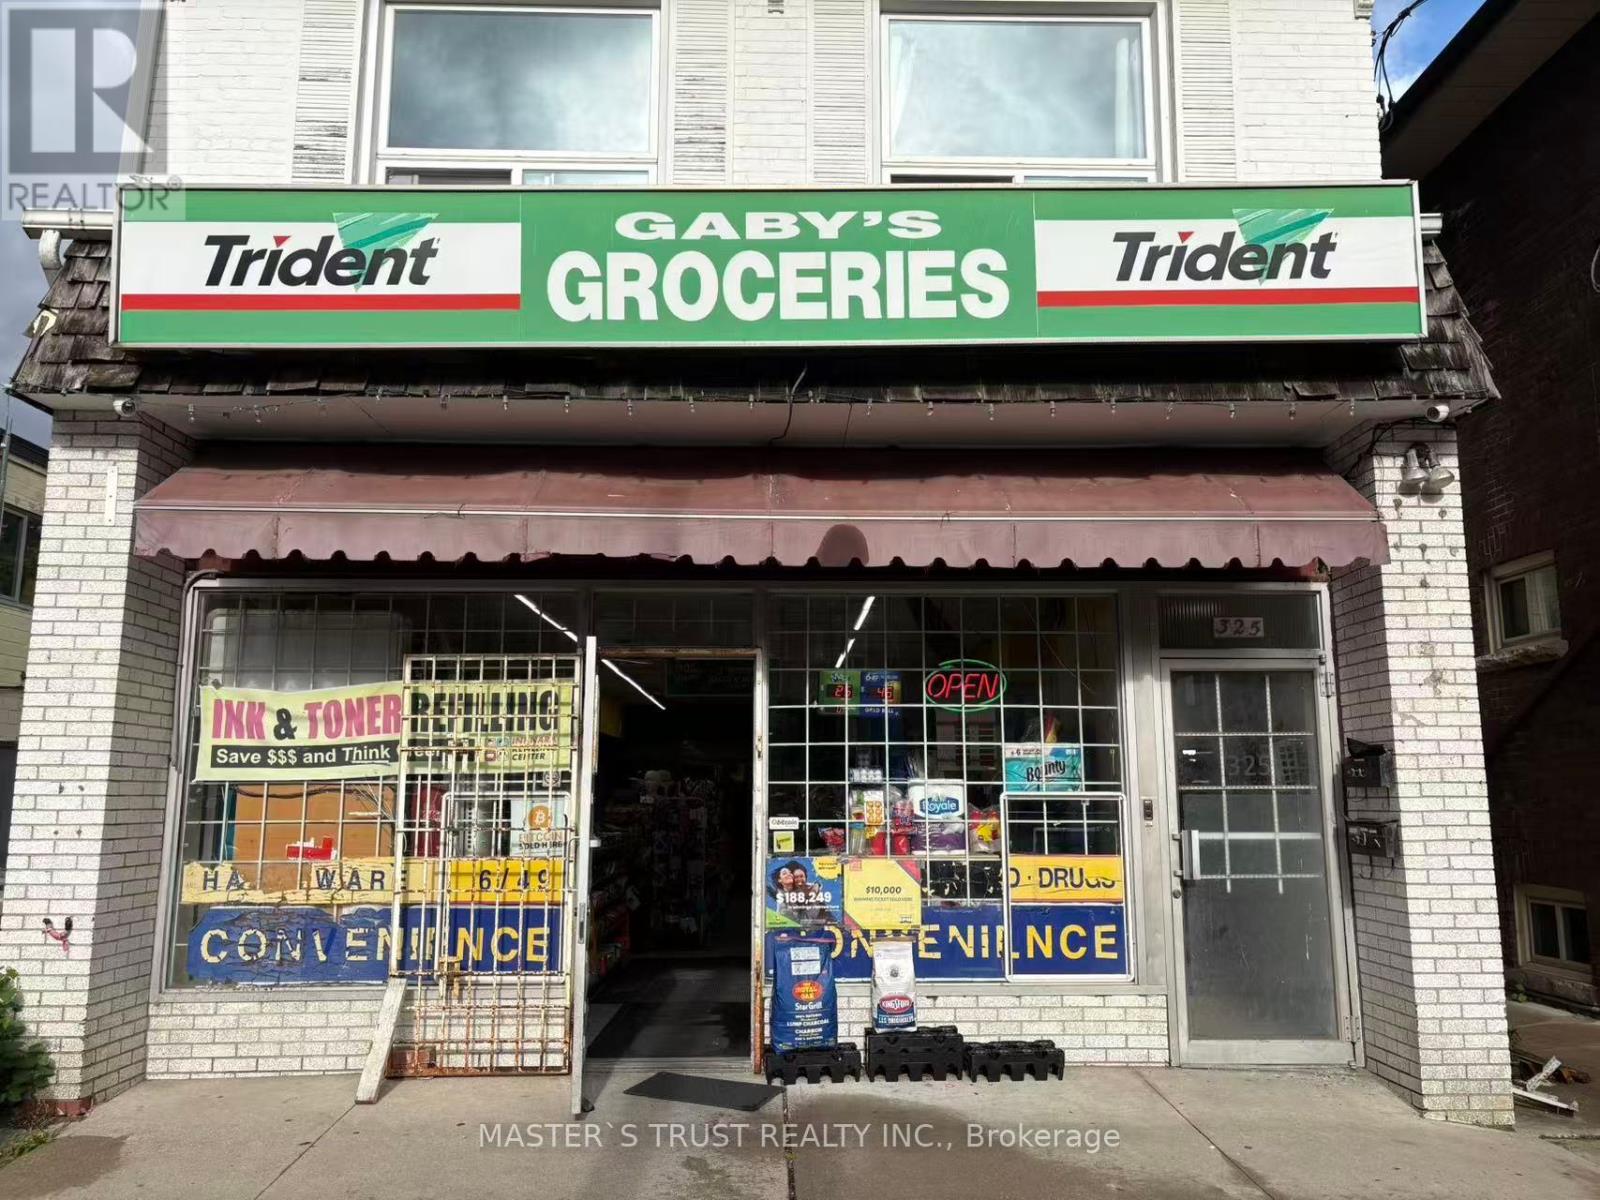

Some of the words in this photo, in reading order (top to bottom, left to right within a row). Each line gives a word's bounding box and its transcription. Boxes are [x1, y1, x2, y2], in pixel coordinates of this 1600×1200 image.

[614, 210, 942, 241] GABY'S
[204, 234, 438, 287] Trident
[1112, 230, 1337, 282] Trident
[546, 248, 1010, 323] GROCERIES
[1215, 618, 1260, 636] 325
[927, 673, 999, 699] OPEN
[212, 698, 267, 741] INK
[273, 707, 299, 741] &
[304, 693, 401, 740] TONER
[216, 748, 262, 765] Save
[267, 748, 298, 766] $$$
[303, 746, 337, 764] and
[342, 744, 391, 764] Think
[776, 891, 832, 905] $188,249
[865, 885, 902, 895] $10,000
